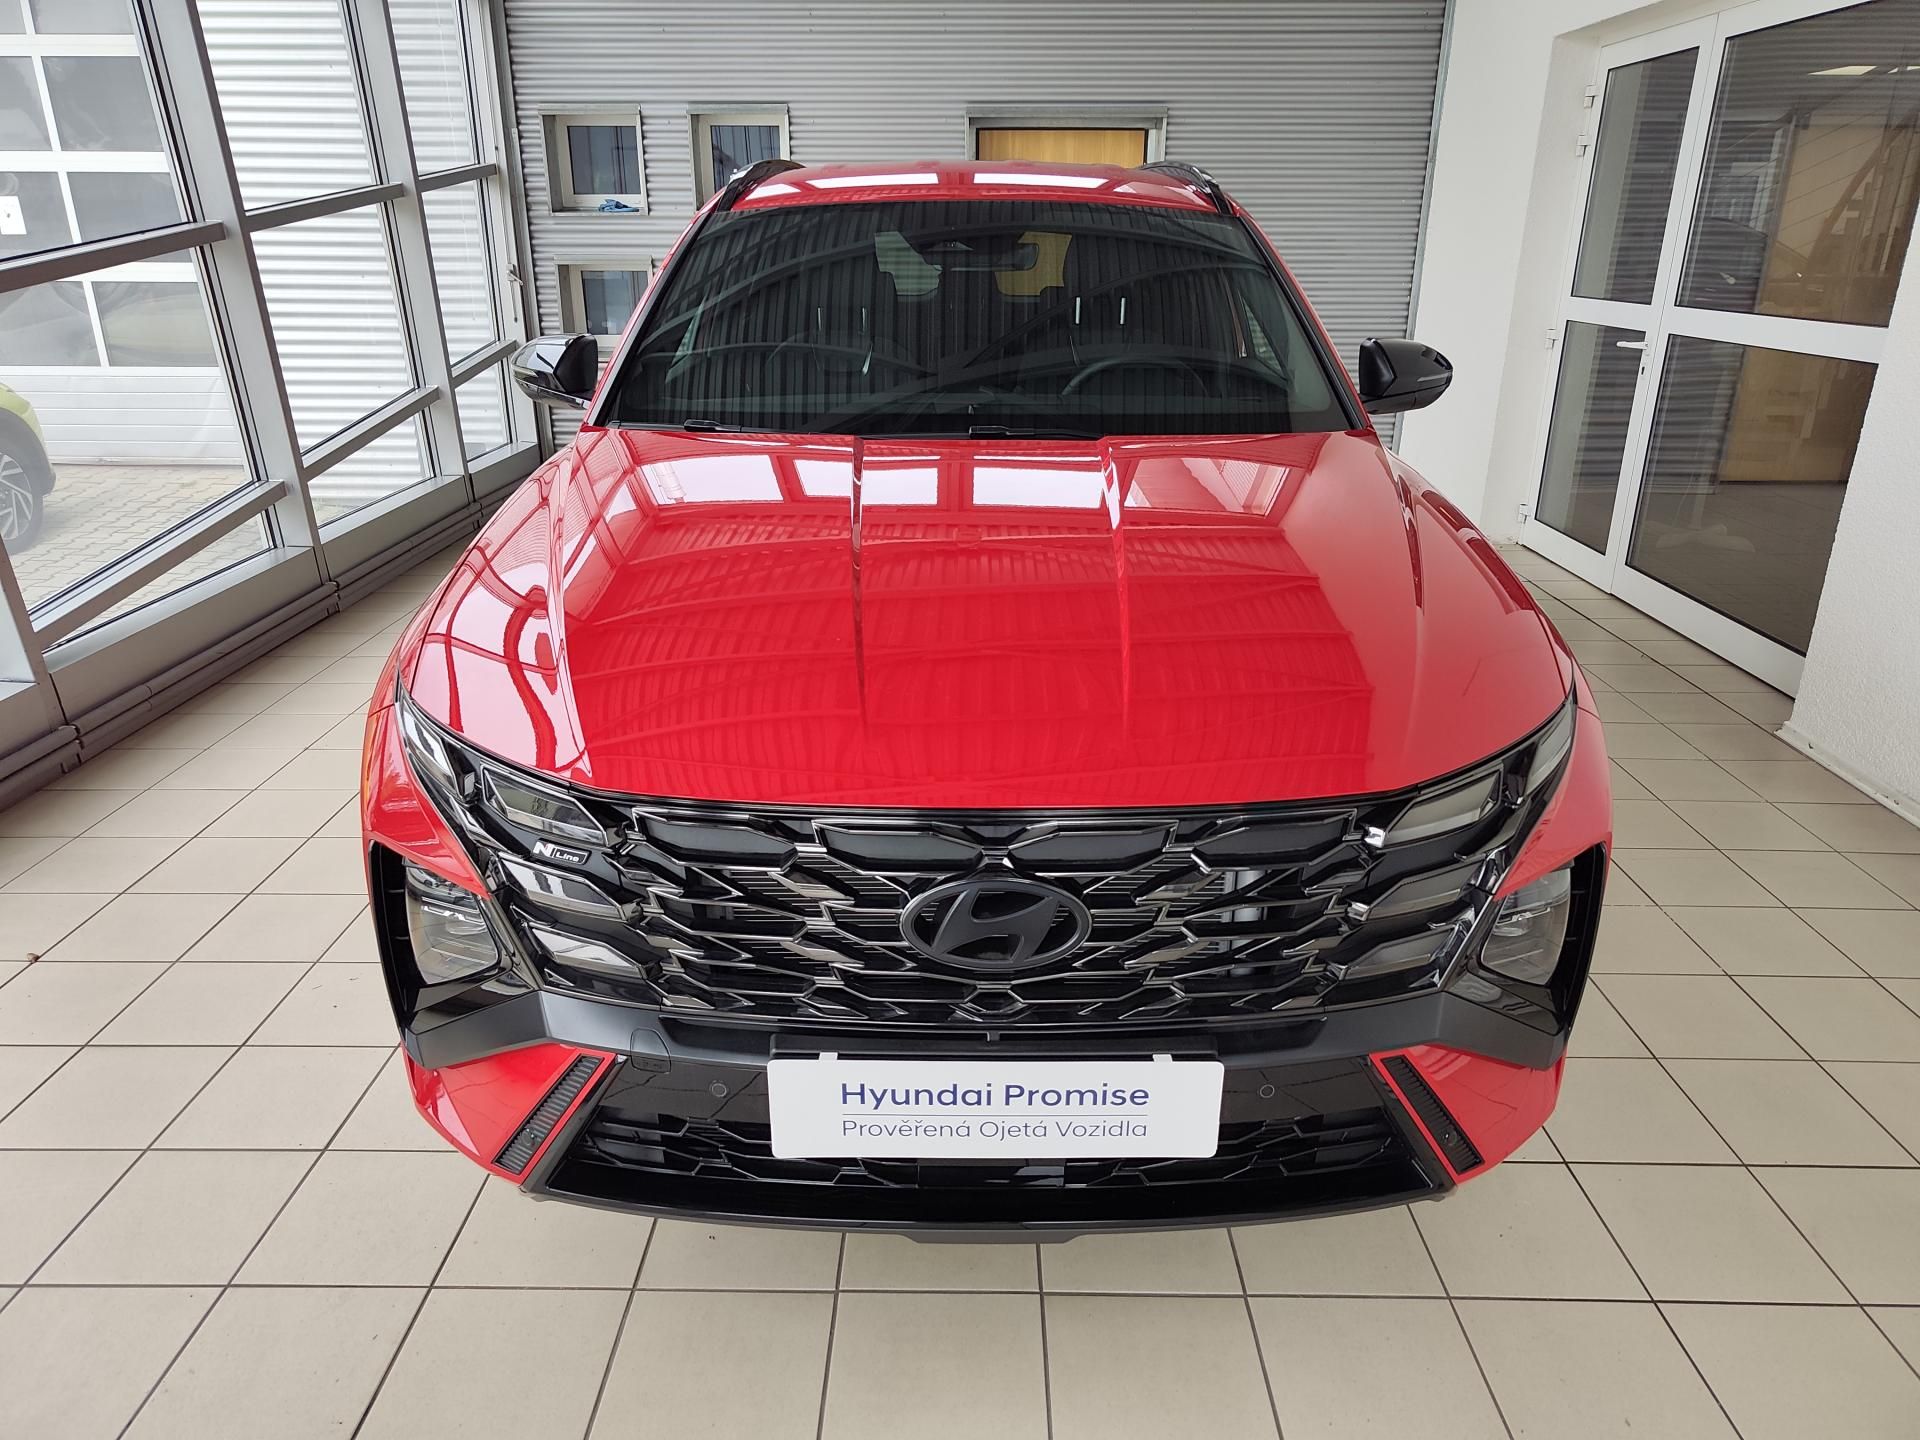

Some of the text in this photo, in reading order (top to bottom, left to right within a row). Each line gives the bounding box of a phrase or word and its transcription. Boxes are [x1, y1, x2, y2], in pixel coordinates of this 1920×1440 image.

[533, 841, 554, 858] N
[841, 1082, 1151, 1111] Hyundai Promise
[842, 1119, 1148, 1142] Prověřená Ojetá Vozidla
